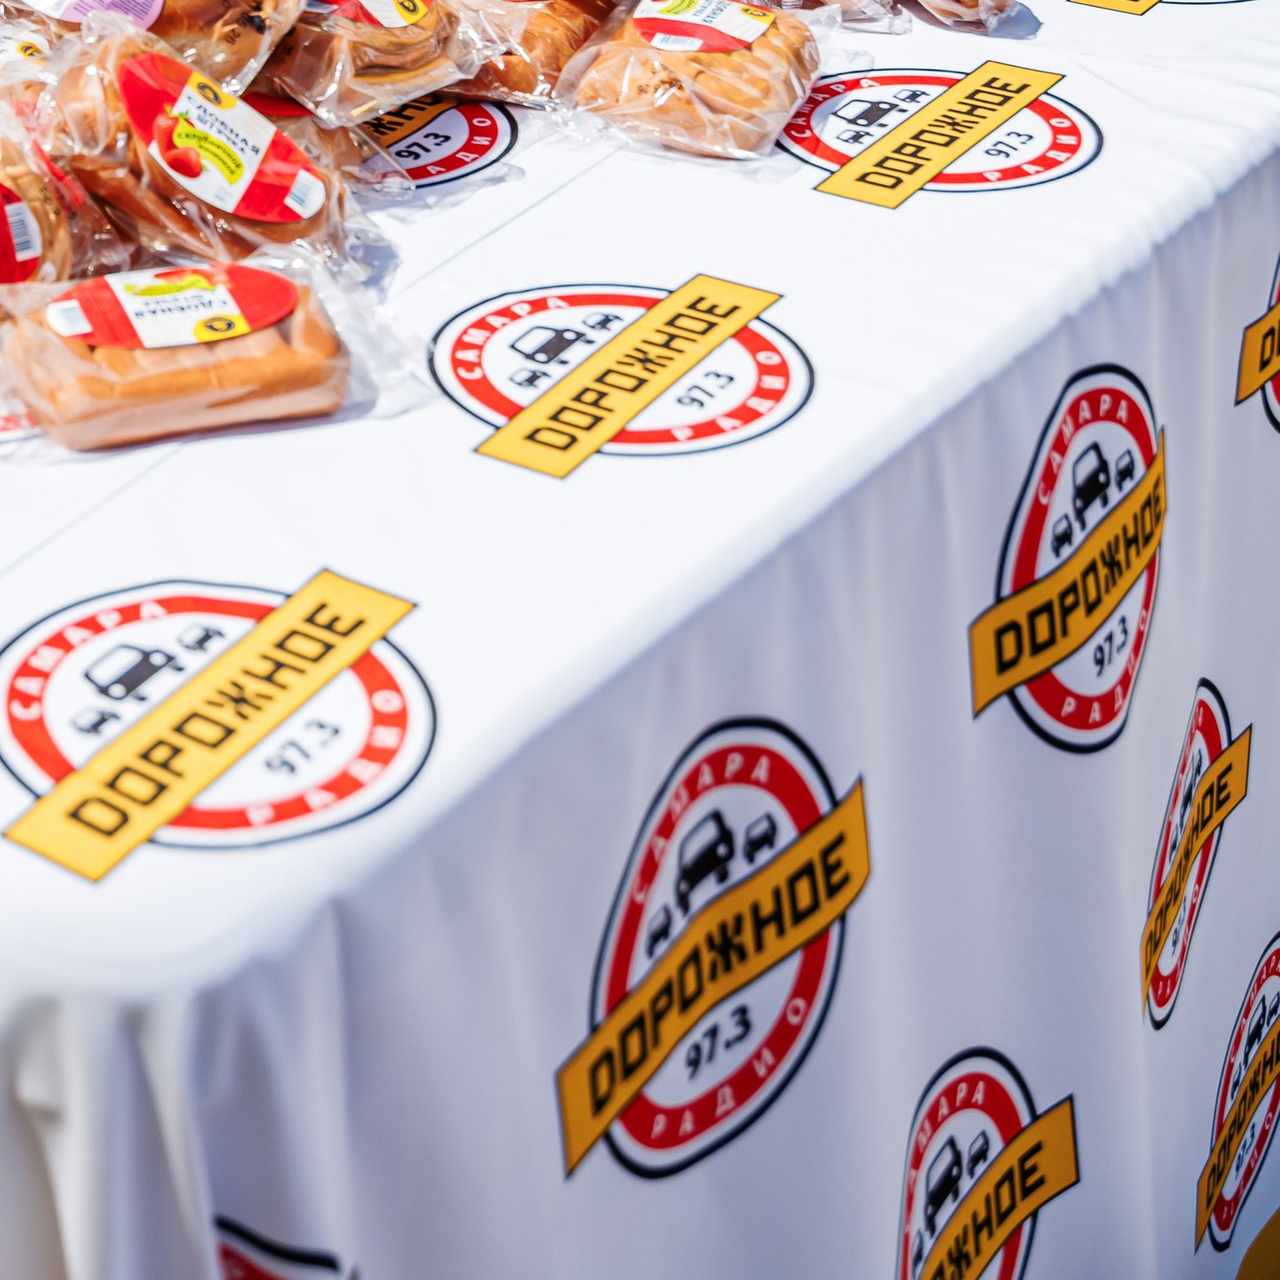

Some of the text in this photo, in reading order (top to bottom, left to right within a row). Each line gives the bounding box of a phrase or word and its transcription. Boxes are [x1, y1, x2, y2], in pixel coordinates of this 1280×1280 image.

[395, 132, 452, 160] 97.3
[790, 78, 880, 139] САМАРА
[985, 131, 1034, 159] 97.3
[985, 118, 1078, 181] РАДИО
[457, 297, 570, 380] САМАРА
[671, 350, 786, 441] РАДИО
[677, 371, 735, 409] 97.3
[1037, 393, 1129, 506] САМАРА
[11, 600, 167, 721] САМАРА
[1093, 616, 1129, 678] 97.3
[246, 689, 403, 826] РАДИО
[264, 719, 341, 775] 97.3
[631, 752, 771, 904] САМАРА
[651, 998, 806, 1139] РАДИО
[685, 1005, 752, 1080] 97.3
